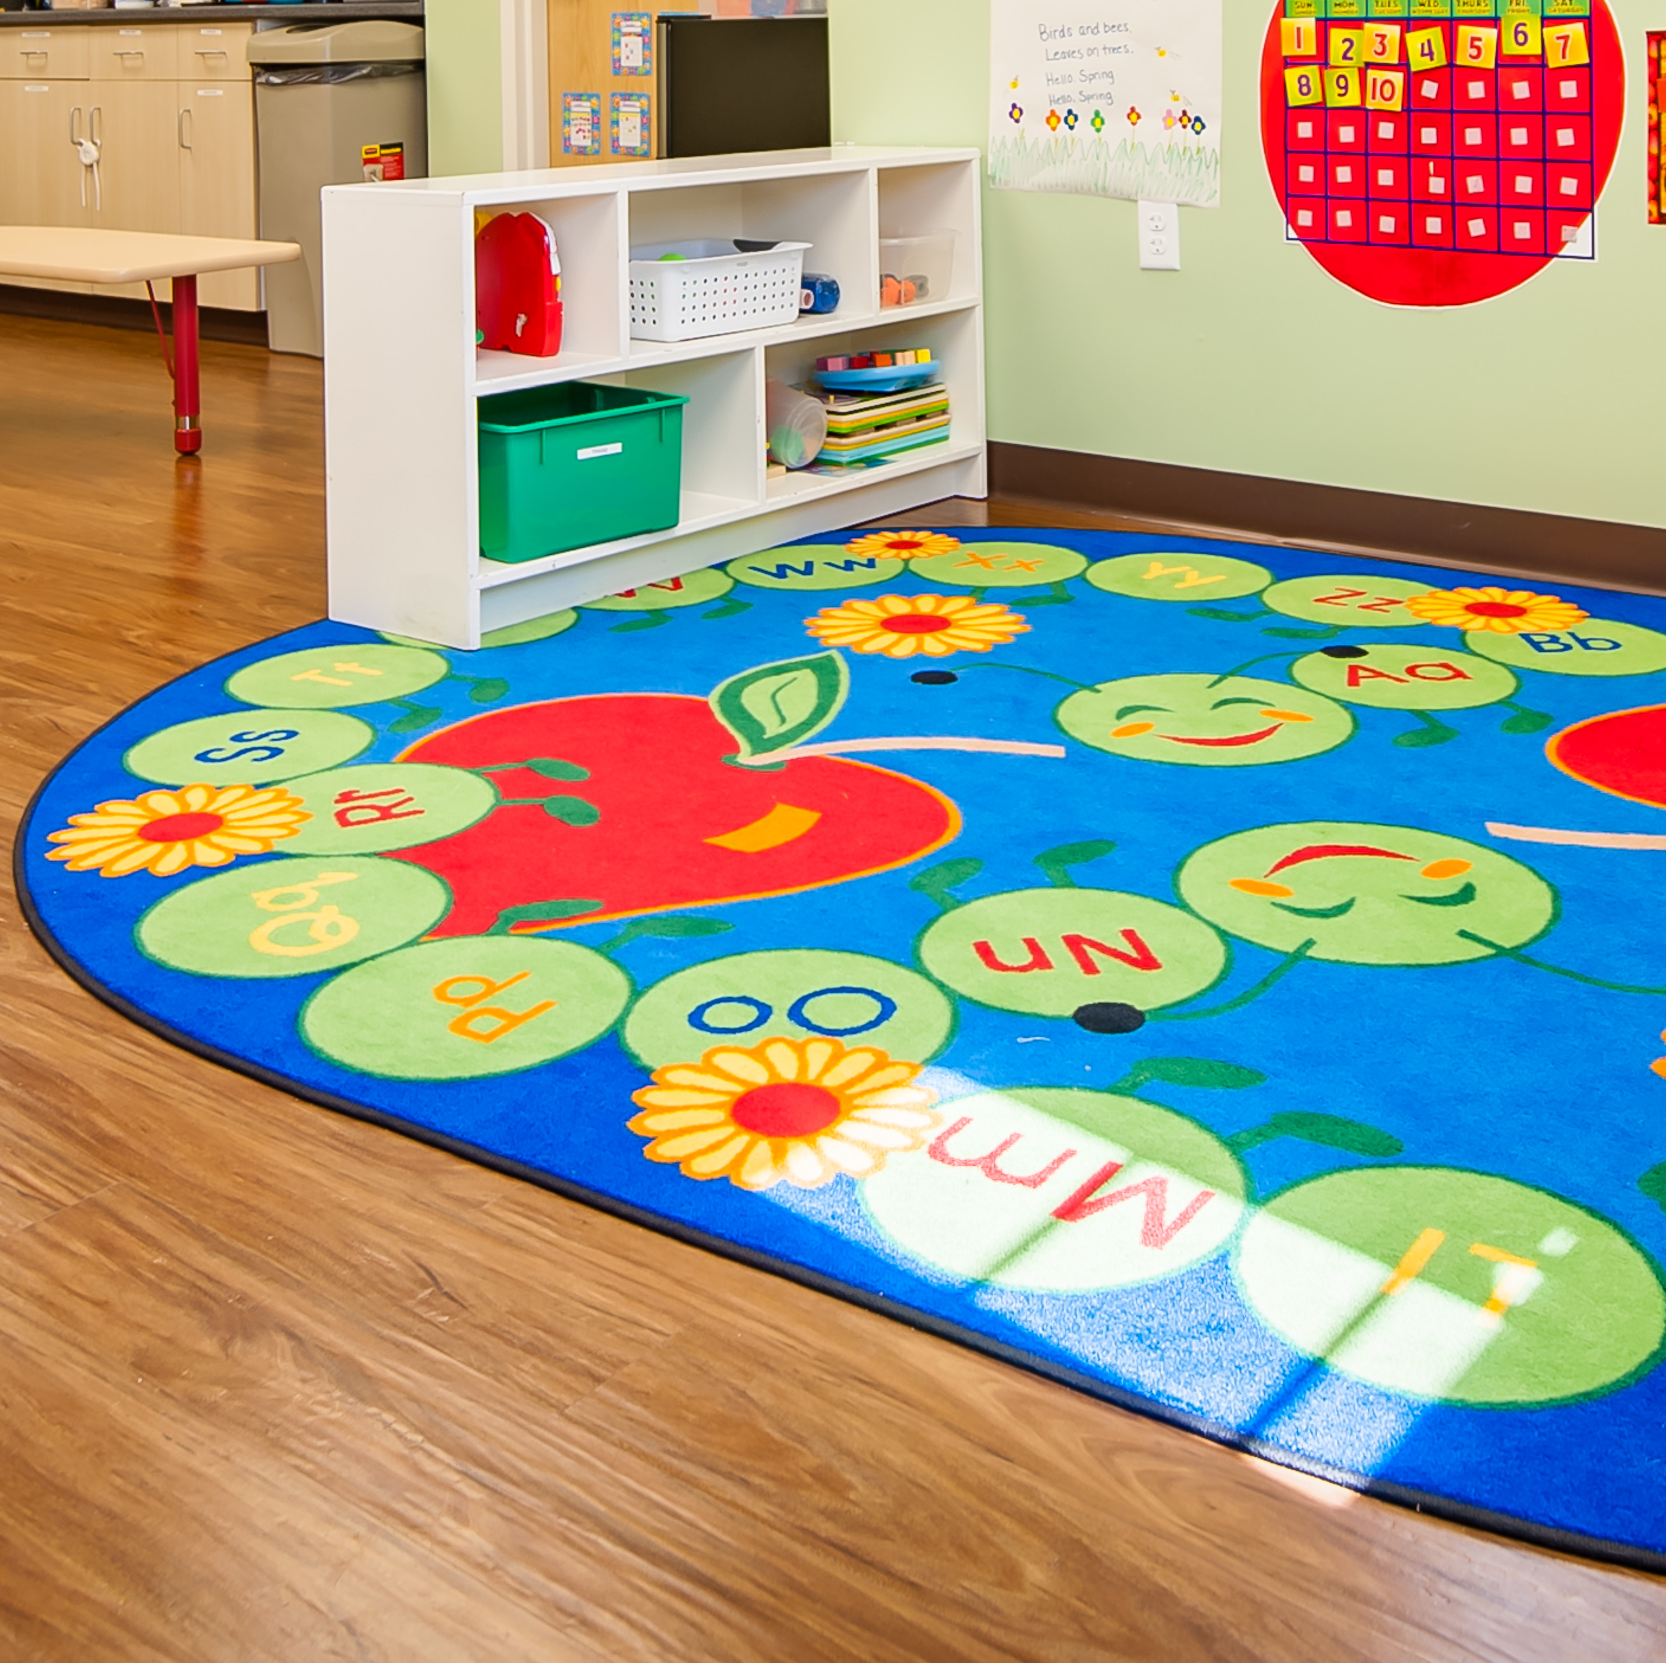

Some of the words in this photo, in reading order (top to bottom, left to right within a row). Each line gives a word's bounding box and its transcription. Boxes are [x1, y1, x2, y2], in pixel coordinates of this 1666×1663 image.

[1038, 23, 1073, 42] Birds
[1079, 22, 1100, 36] and
[1294, 25, 1303, 50] 1
[1513, 21, 1529, 47] 6
[1045, 47, 1084, 61] Leaves
[1086, 46, 1100, 57] on
[1341, 38, 1355, 61] 2
[1373, 33, 1388, 57] 3
[1419, 38, 1435, 62] 4
[1468, 35, 1483, 61] 5
[1555, 34, 1572, 60] 7
[1079, 69, 1115, 85] Spring
[1297, 74, 1312, 98] 8
[1335, 74, 1350, 98] 9
[1078, 90, 1115, 106] Spring
[1371, 78, 1396, 103] 10
[748, 556, 878, 580] Ww
[952, 551, 1044, 573] Xx
[1141, 561, 1226, 590] Yy
[1313, 588, 1406, 613] Zz
[1517, 631, 1623, 655] Bb
[290, 661, 383, 687] Tt
[1346, 662, 1472, 689] Aa
[194, 728, 300, 763] Ss
[333, 788, 425, 829] Rr
[973, 927, 1164, 977] Nn
[688, 985, 897, 1036] Oo
[927, 1116, 1218, 1250] Mm
